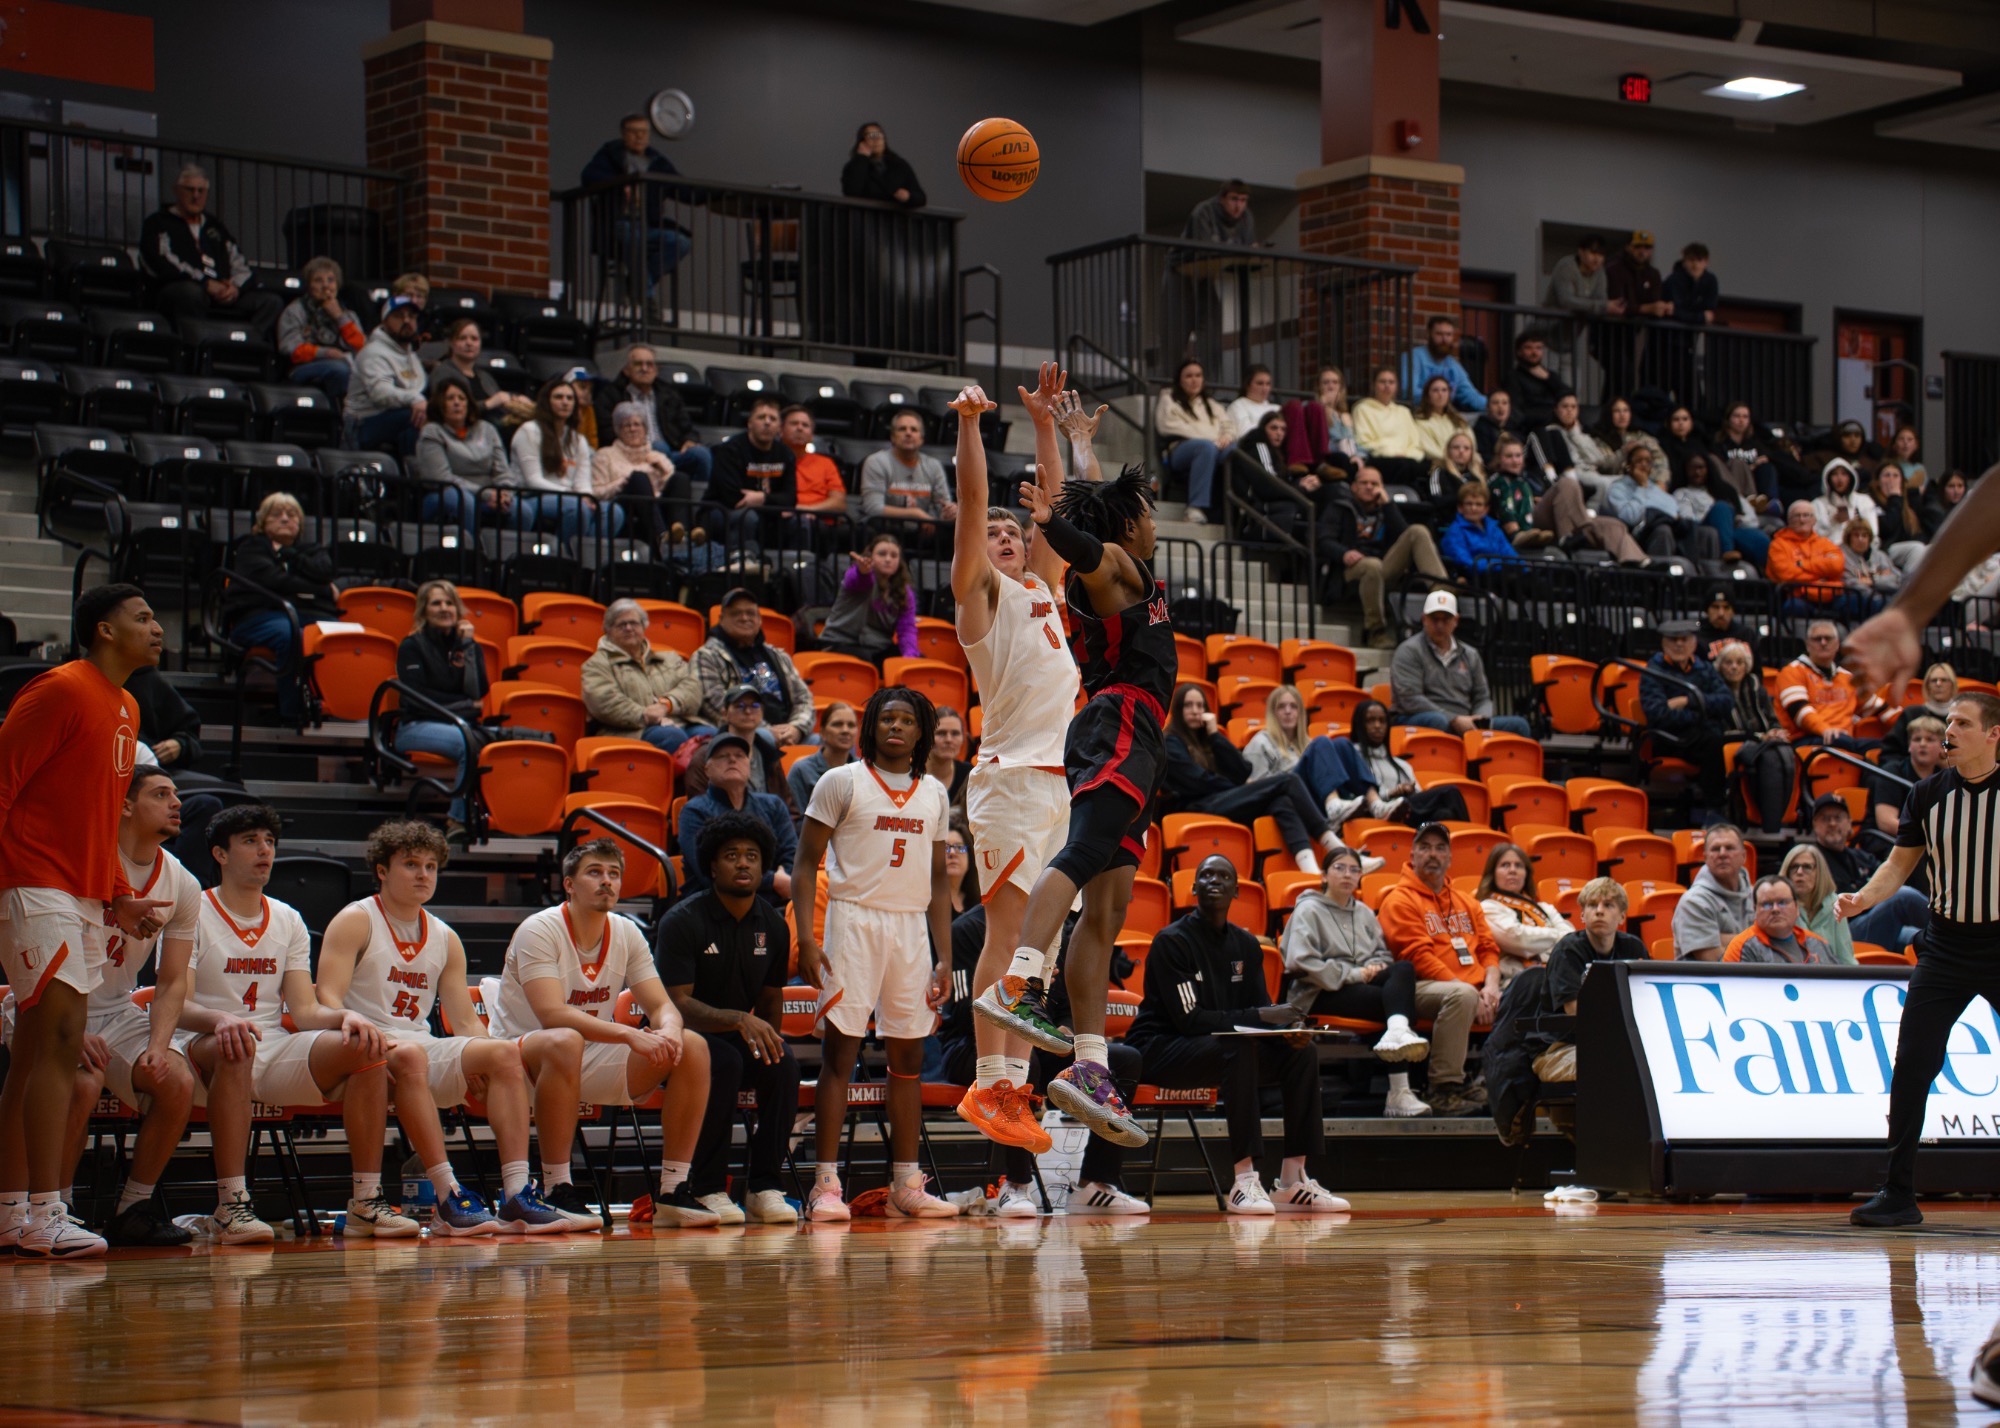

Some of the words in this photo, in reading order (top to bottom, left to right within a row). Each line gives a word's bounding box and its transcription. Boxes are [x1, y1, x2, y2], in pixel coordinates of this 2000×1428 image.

[1626, 77, 1650, 102] EXIT
[1002, 141, 1030, 155] EVO
[992, 166, 1038, 187] Wilson
[1042, 622, 1061, 649] 0
[874, 815, 924, 834] JIMMIES
[890, 838, 907, 867] 5
[983, 849, 1000, 870] U
[20, 946, 40, 970] U
[223, 957, 277, 974] JIMMIES
[242, 981, 259, 1012] 4
[1155, 1087, 1211, 1101] JIMMIES
